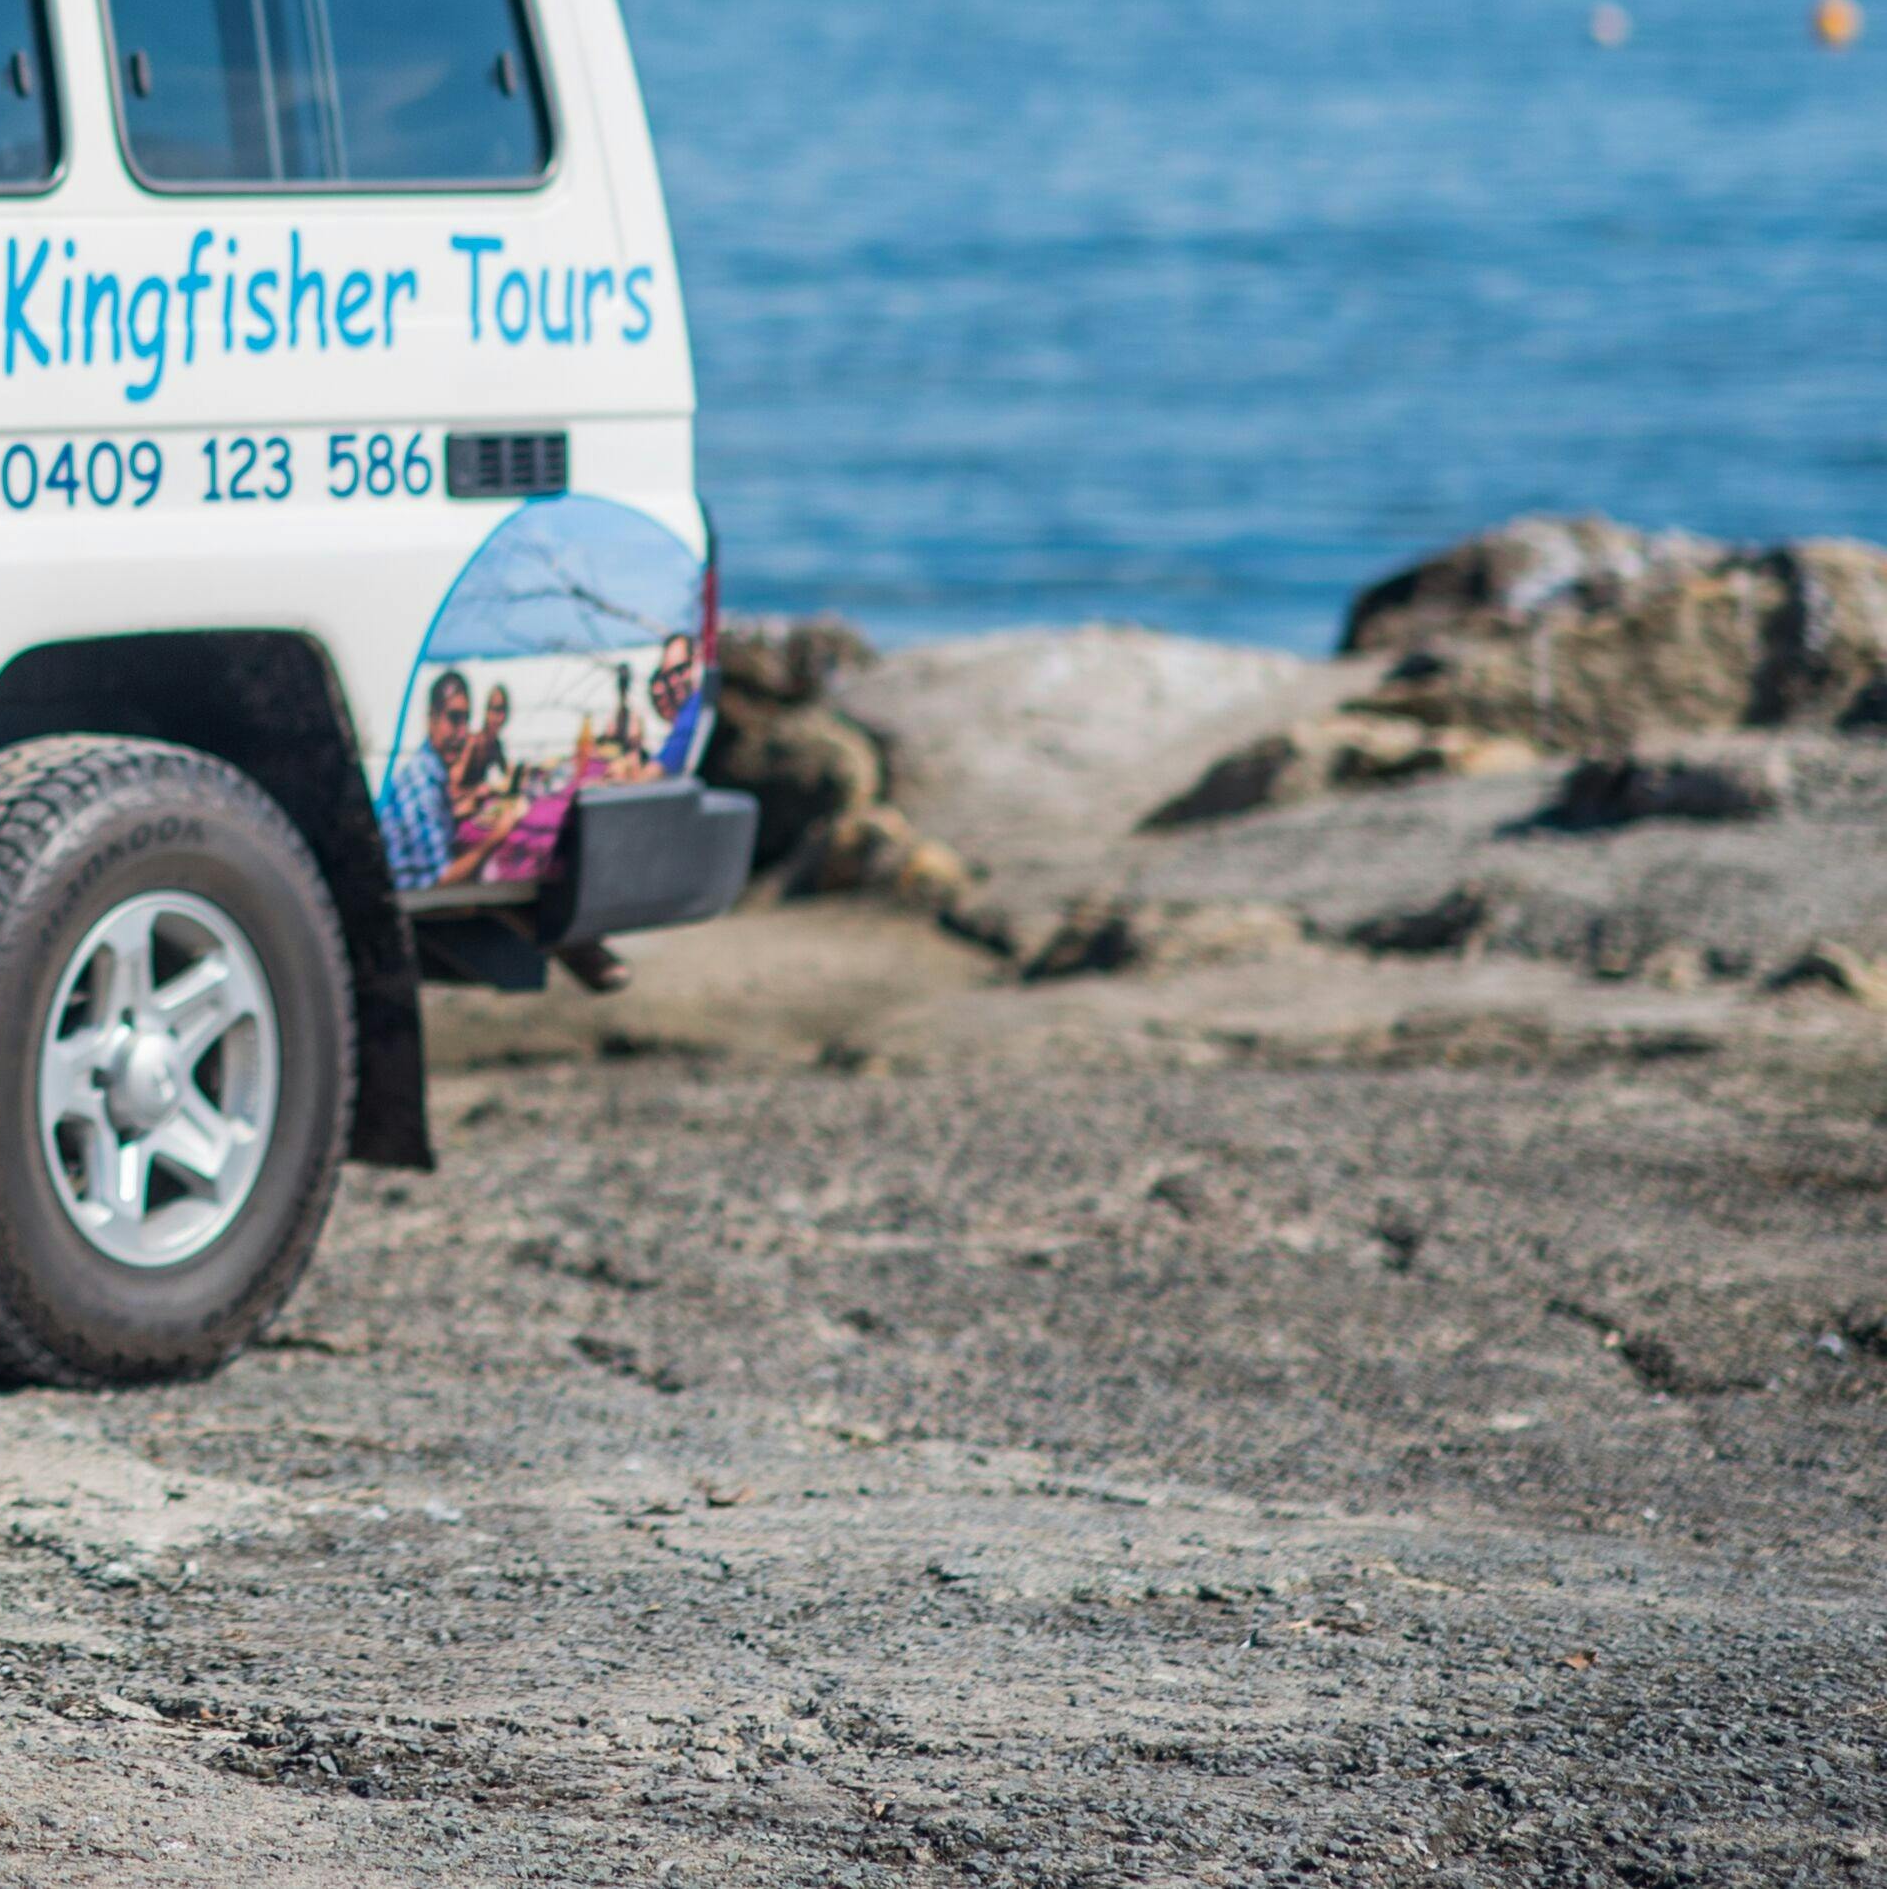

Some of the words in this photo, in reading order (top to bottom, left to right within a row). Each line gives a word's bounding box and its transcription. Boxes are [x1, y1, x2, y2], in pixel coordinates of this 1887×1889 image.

[3, 228, 419, 402] Kingfisher
[450, 234, 656, 346] Tours
[0, 440, 164, 510] 0409
[200, 435, 294, 502] 123
[328, 431, 431, 499] 586
